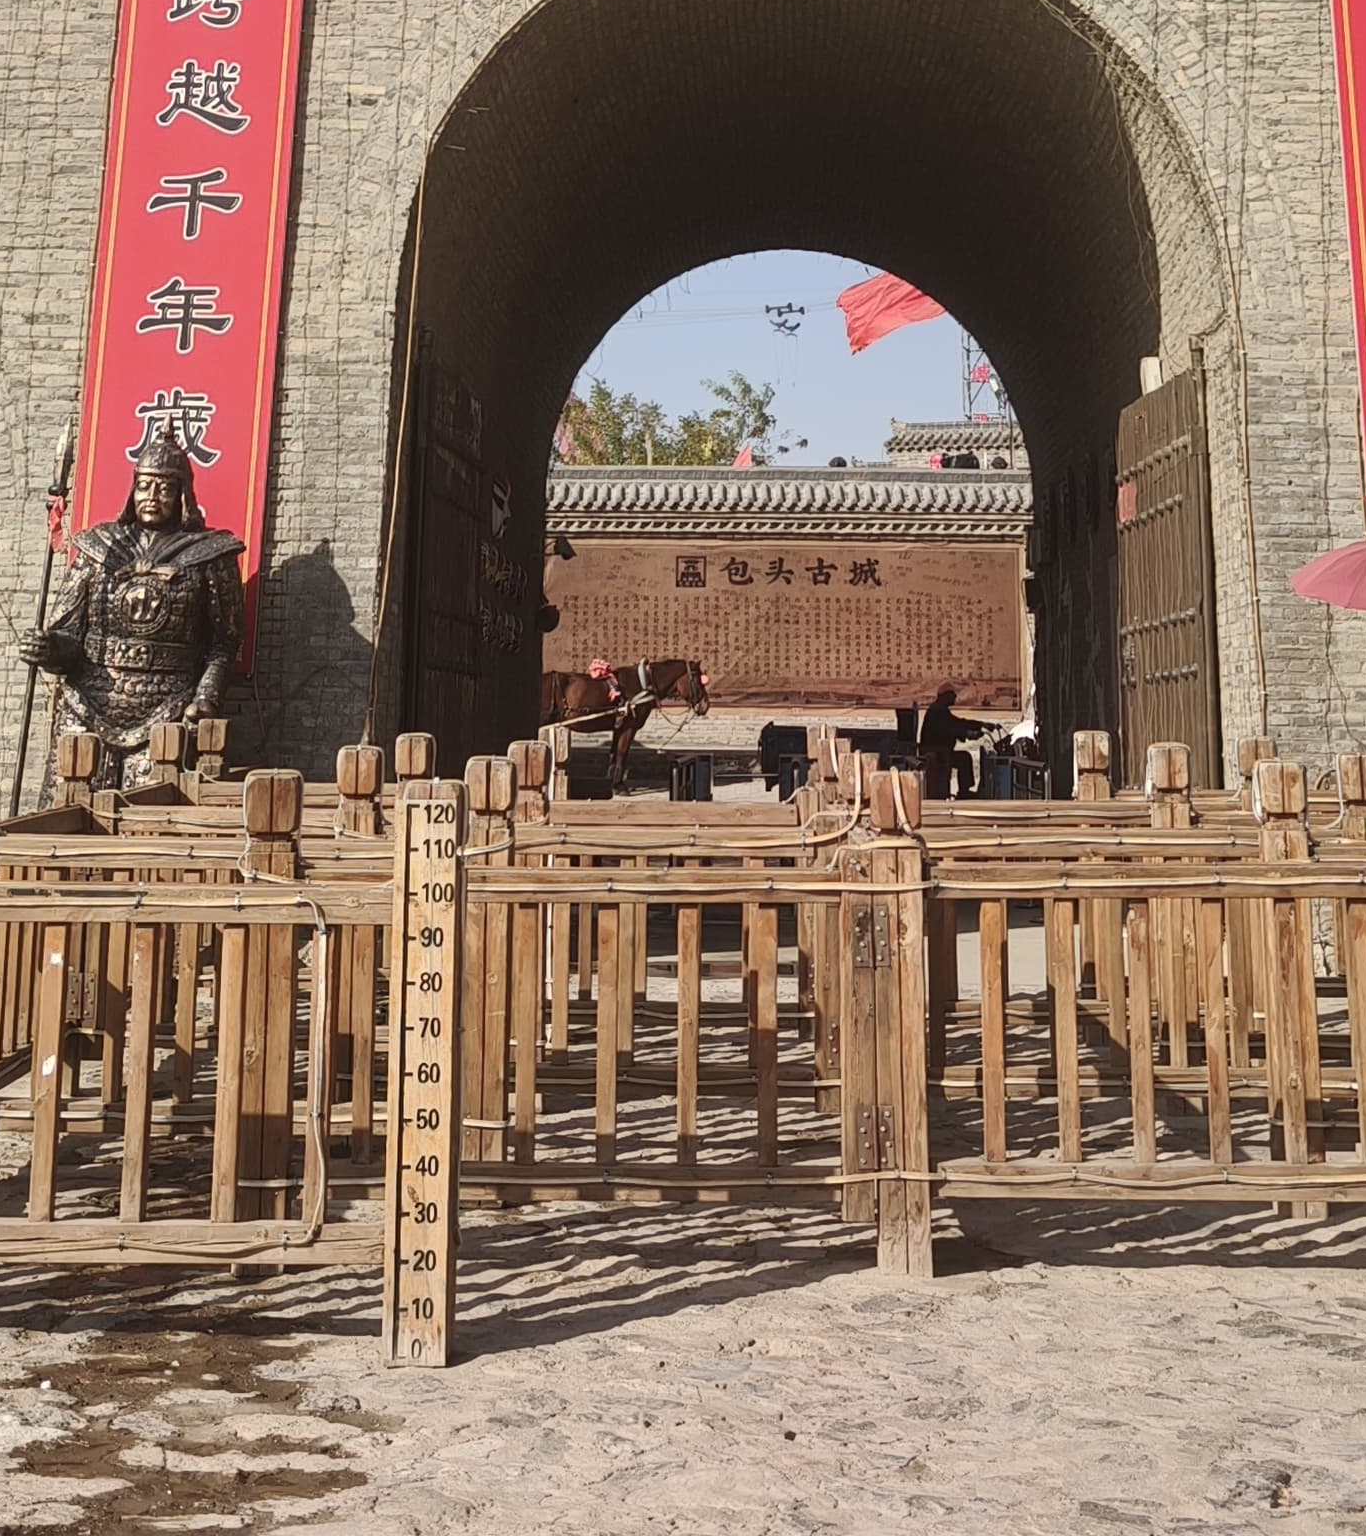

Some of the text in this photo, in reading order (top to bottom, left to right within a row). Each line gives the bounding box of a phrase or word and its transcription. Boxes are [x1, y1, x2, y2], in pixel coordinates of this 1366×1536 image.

[719, 557, 883, 586] 包头古城
[423, 803, 455, 825] 120
[422, 838, 455, 859] 110
[421, 882, 455, 903] 100
[420, 926, 444, 948] 90
[419, 971, 443, 993] 80
[418, 1016, 441, 1038] 70
[417, 1062, 440, 1084] 60
[416, 1108, 440, 1130] 50
[414, 1154, 439, 1177] 40
[413, 1202, 438, 1224] 30
[412, 1249, 436, 1272] 20
[411, 1296, 434, 1320] 10
[410, 1338, 423, 1360] 0
